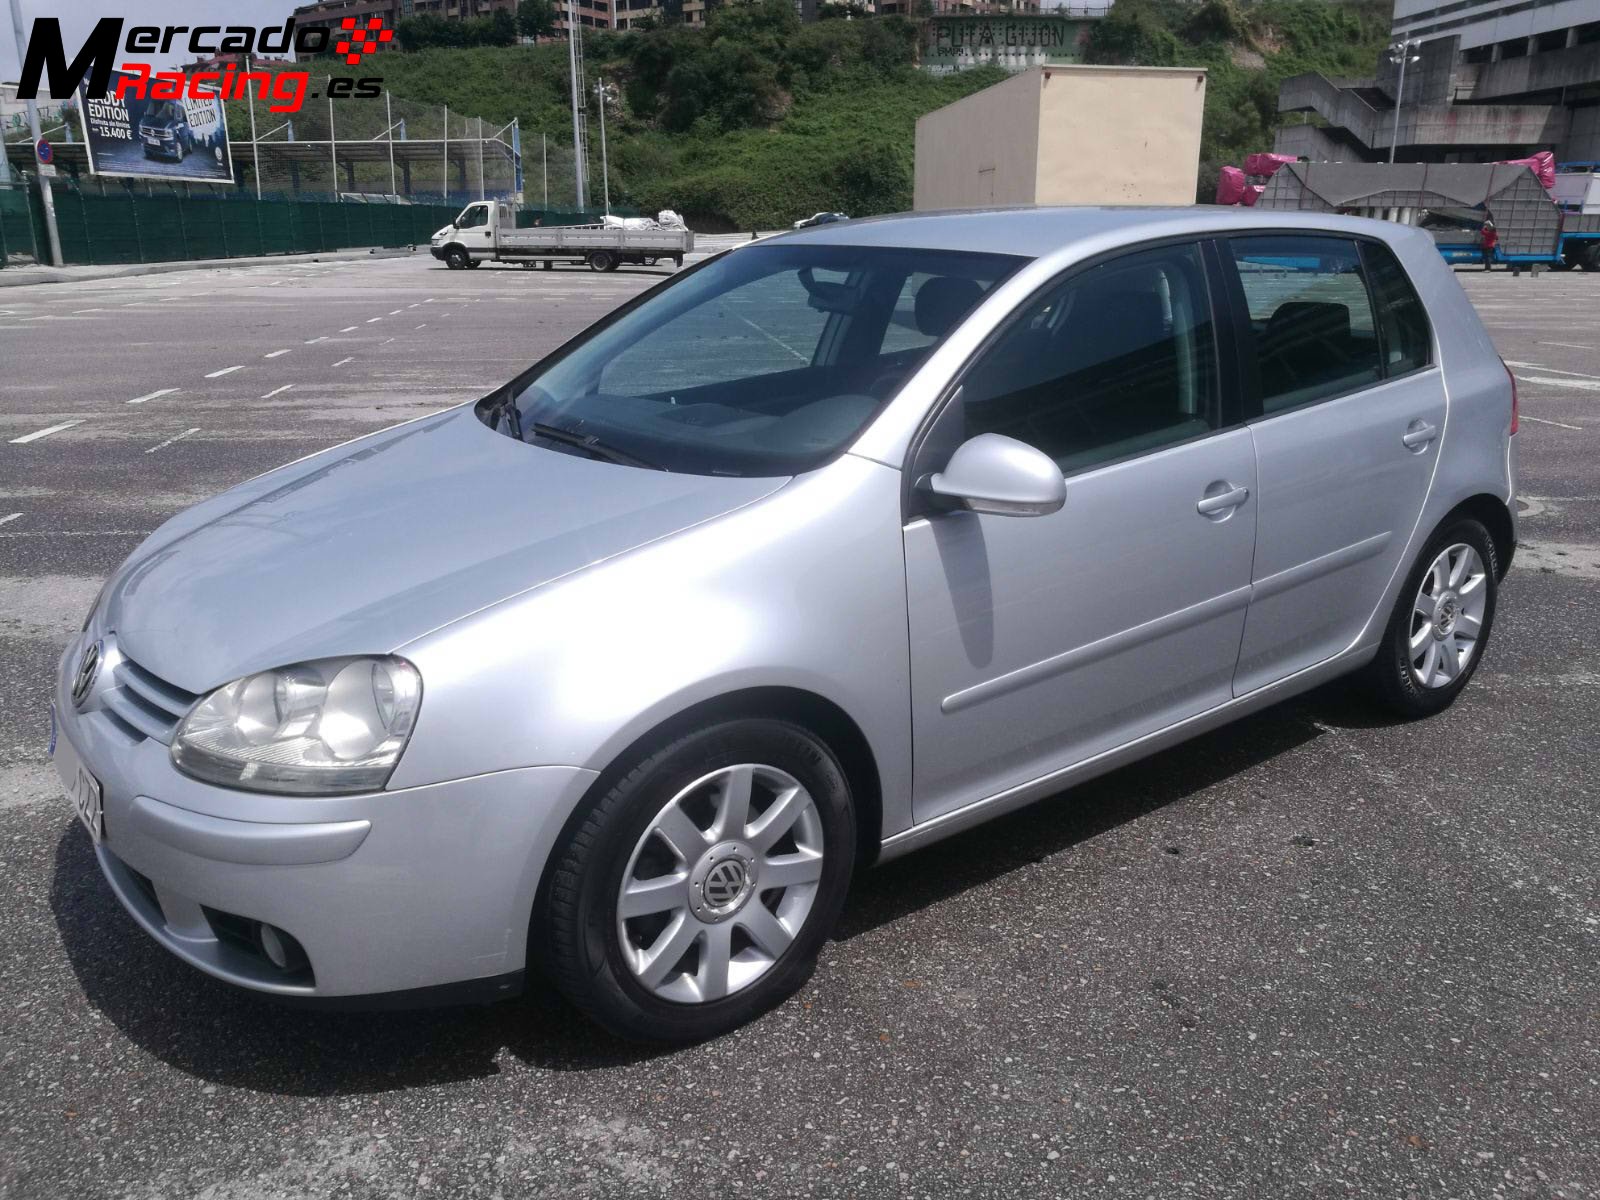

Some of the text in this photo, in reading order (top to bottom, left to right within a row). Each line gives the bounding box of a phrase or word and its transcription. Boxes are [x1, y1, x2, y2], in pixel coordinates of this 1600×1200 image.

[936, 24, 994, 48] PUTA
[88, 103, 130, 122] EDITION
[188, 109, 216, 127] EDITION
[100, 127, 126, 139] 15.400
[127, 129, 133, 140] €
